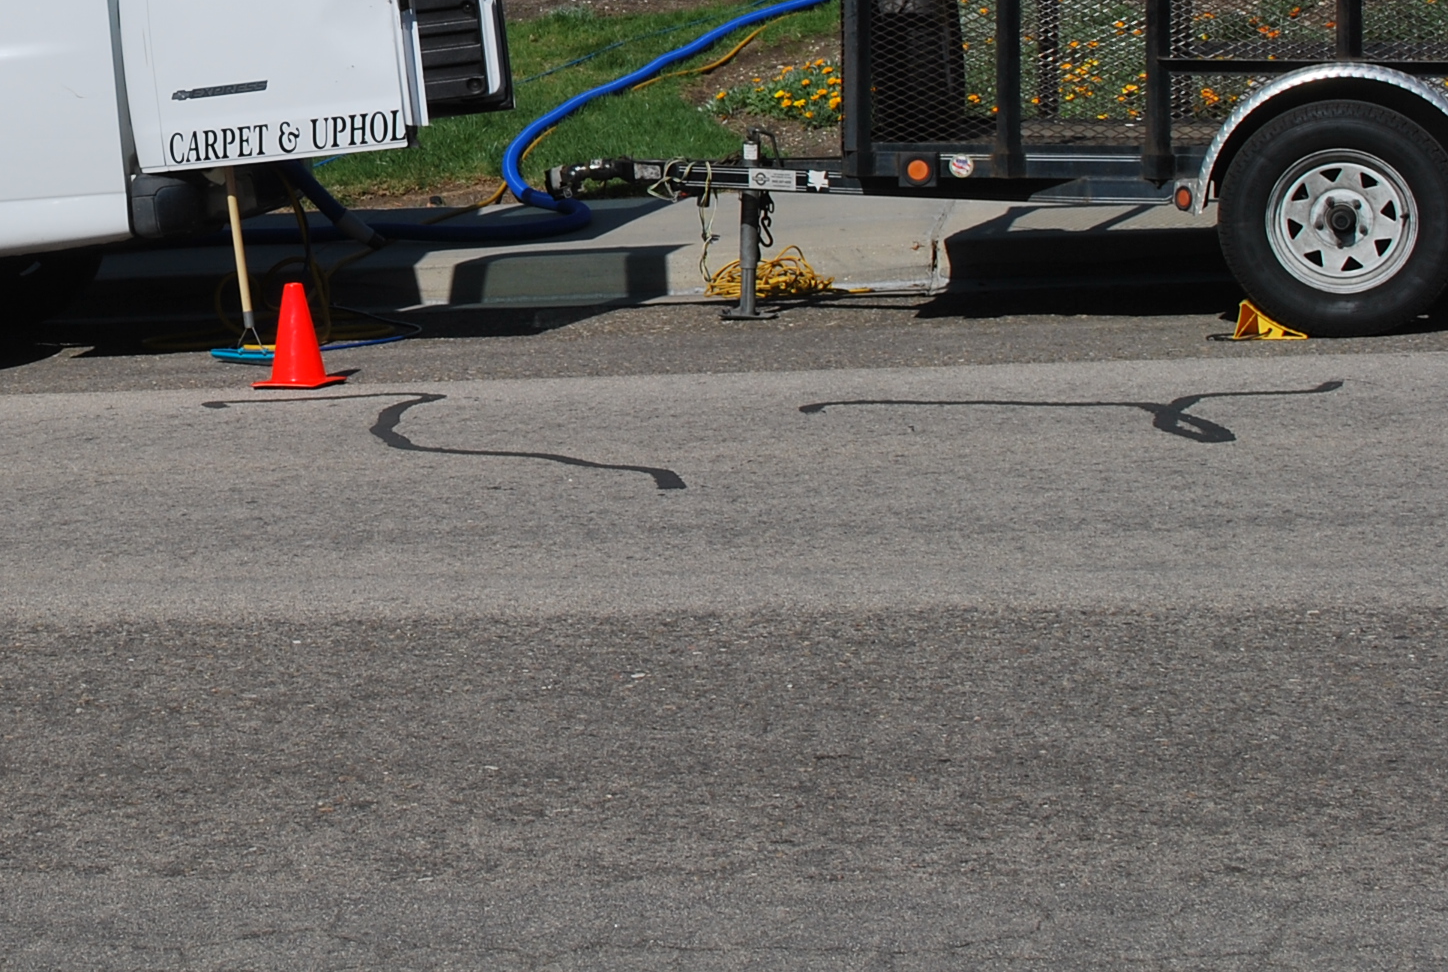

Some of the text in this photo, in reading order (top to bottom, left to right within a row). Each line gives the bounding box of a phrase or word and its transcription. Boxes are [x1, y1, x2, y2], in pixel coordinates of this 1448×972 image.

[193, 80, 267, 98] EXPRESS
[169, 109, 406, 165] CARPET & UPHOL
